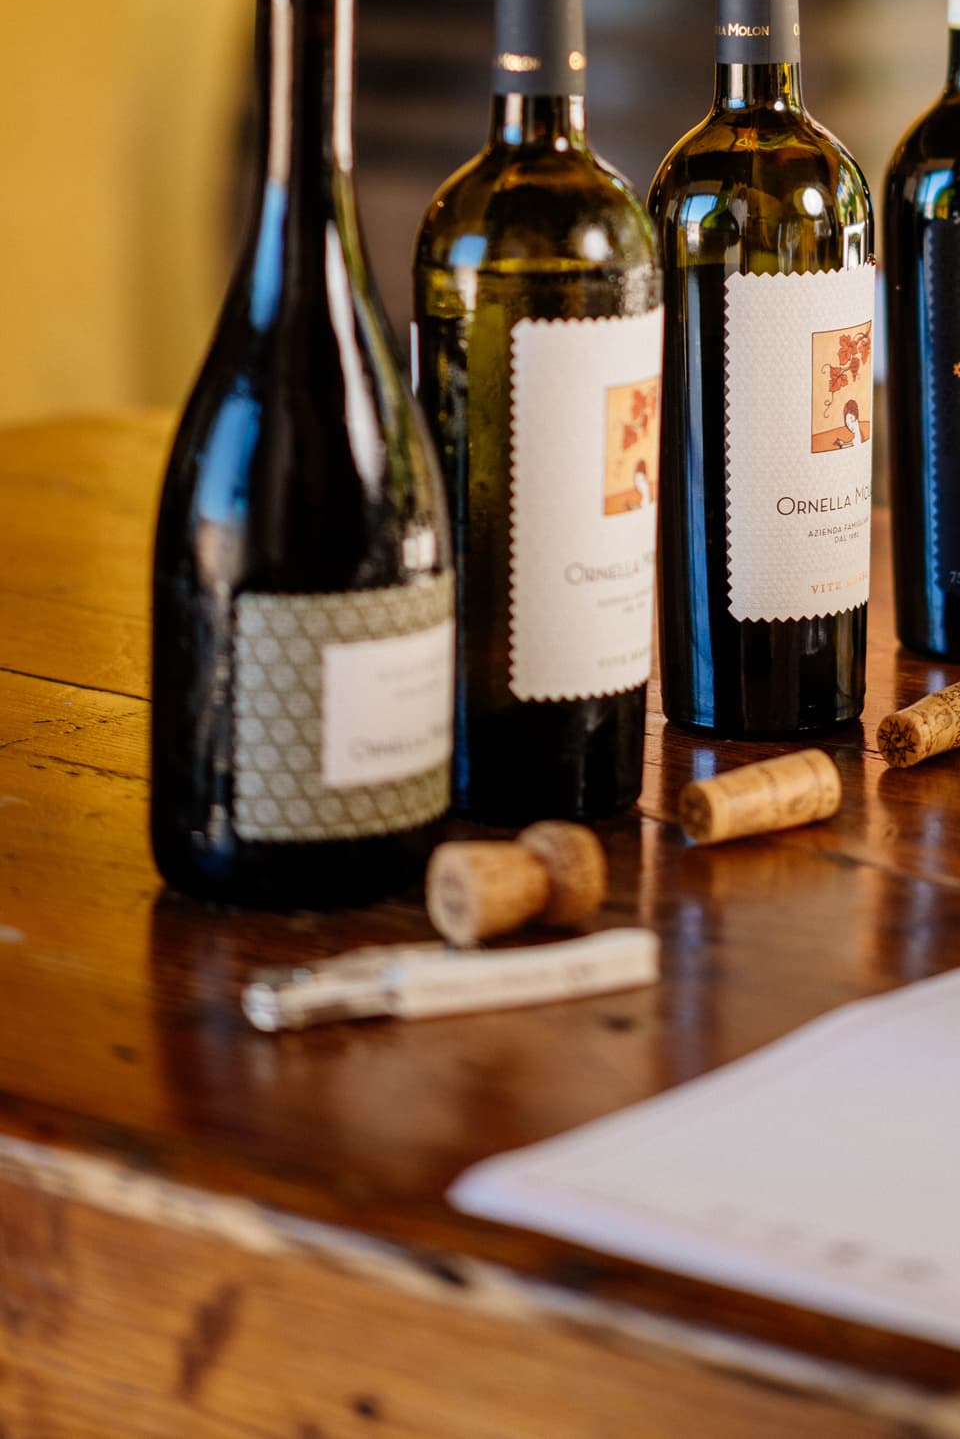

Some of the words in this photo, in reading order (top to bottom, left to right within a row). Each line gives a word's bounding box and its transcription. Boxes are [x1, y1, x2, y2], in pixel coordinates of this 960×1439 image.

[728, 23, 770, 37] MOLON
[776, 495, 852, 516] ORNELLA
[808, 526, 842, 537] AZIENDA
[834, 534, 847, 544] DAL
[810, 580, 841, 594] VITE
